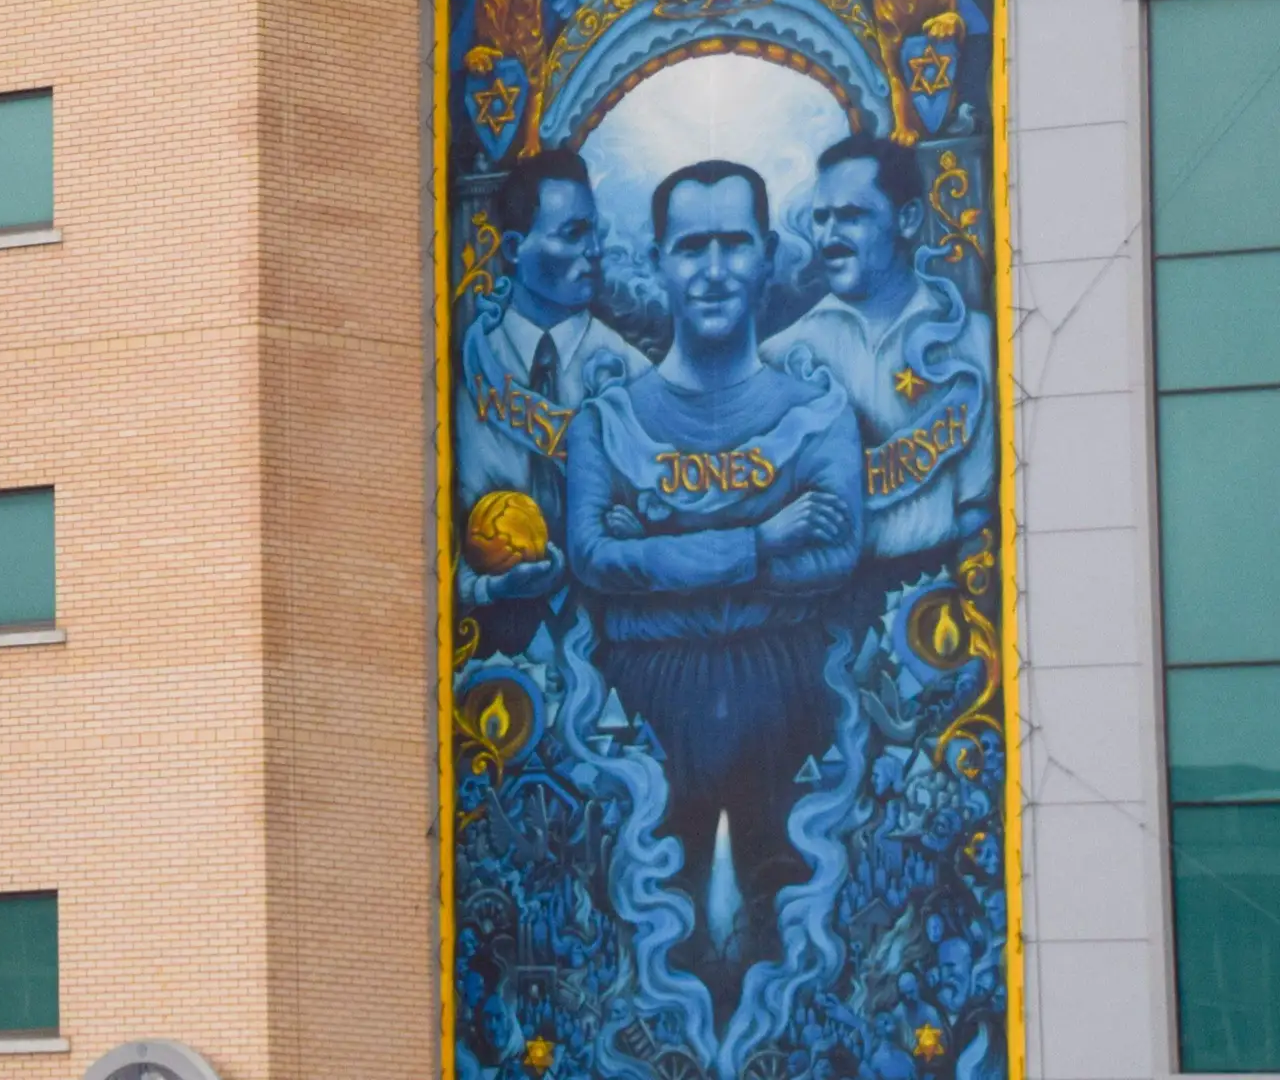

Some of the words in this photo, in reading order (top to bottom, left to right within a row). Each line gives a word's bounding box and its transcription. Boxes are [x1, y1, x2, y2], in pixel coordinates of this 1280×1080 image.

[474, 373, 576, 460] WEISZ
[864, 403, 968, 496] HIRSCH
[655, 446, 779, 493] JONES
